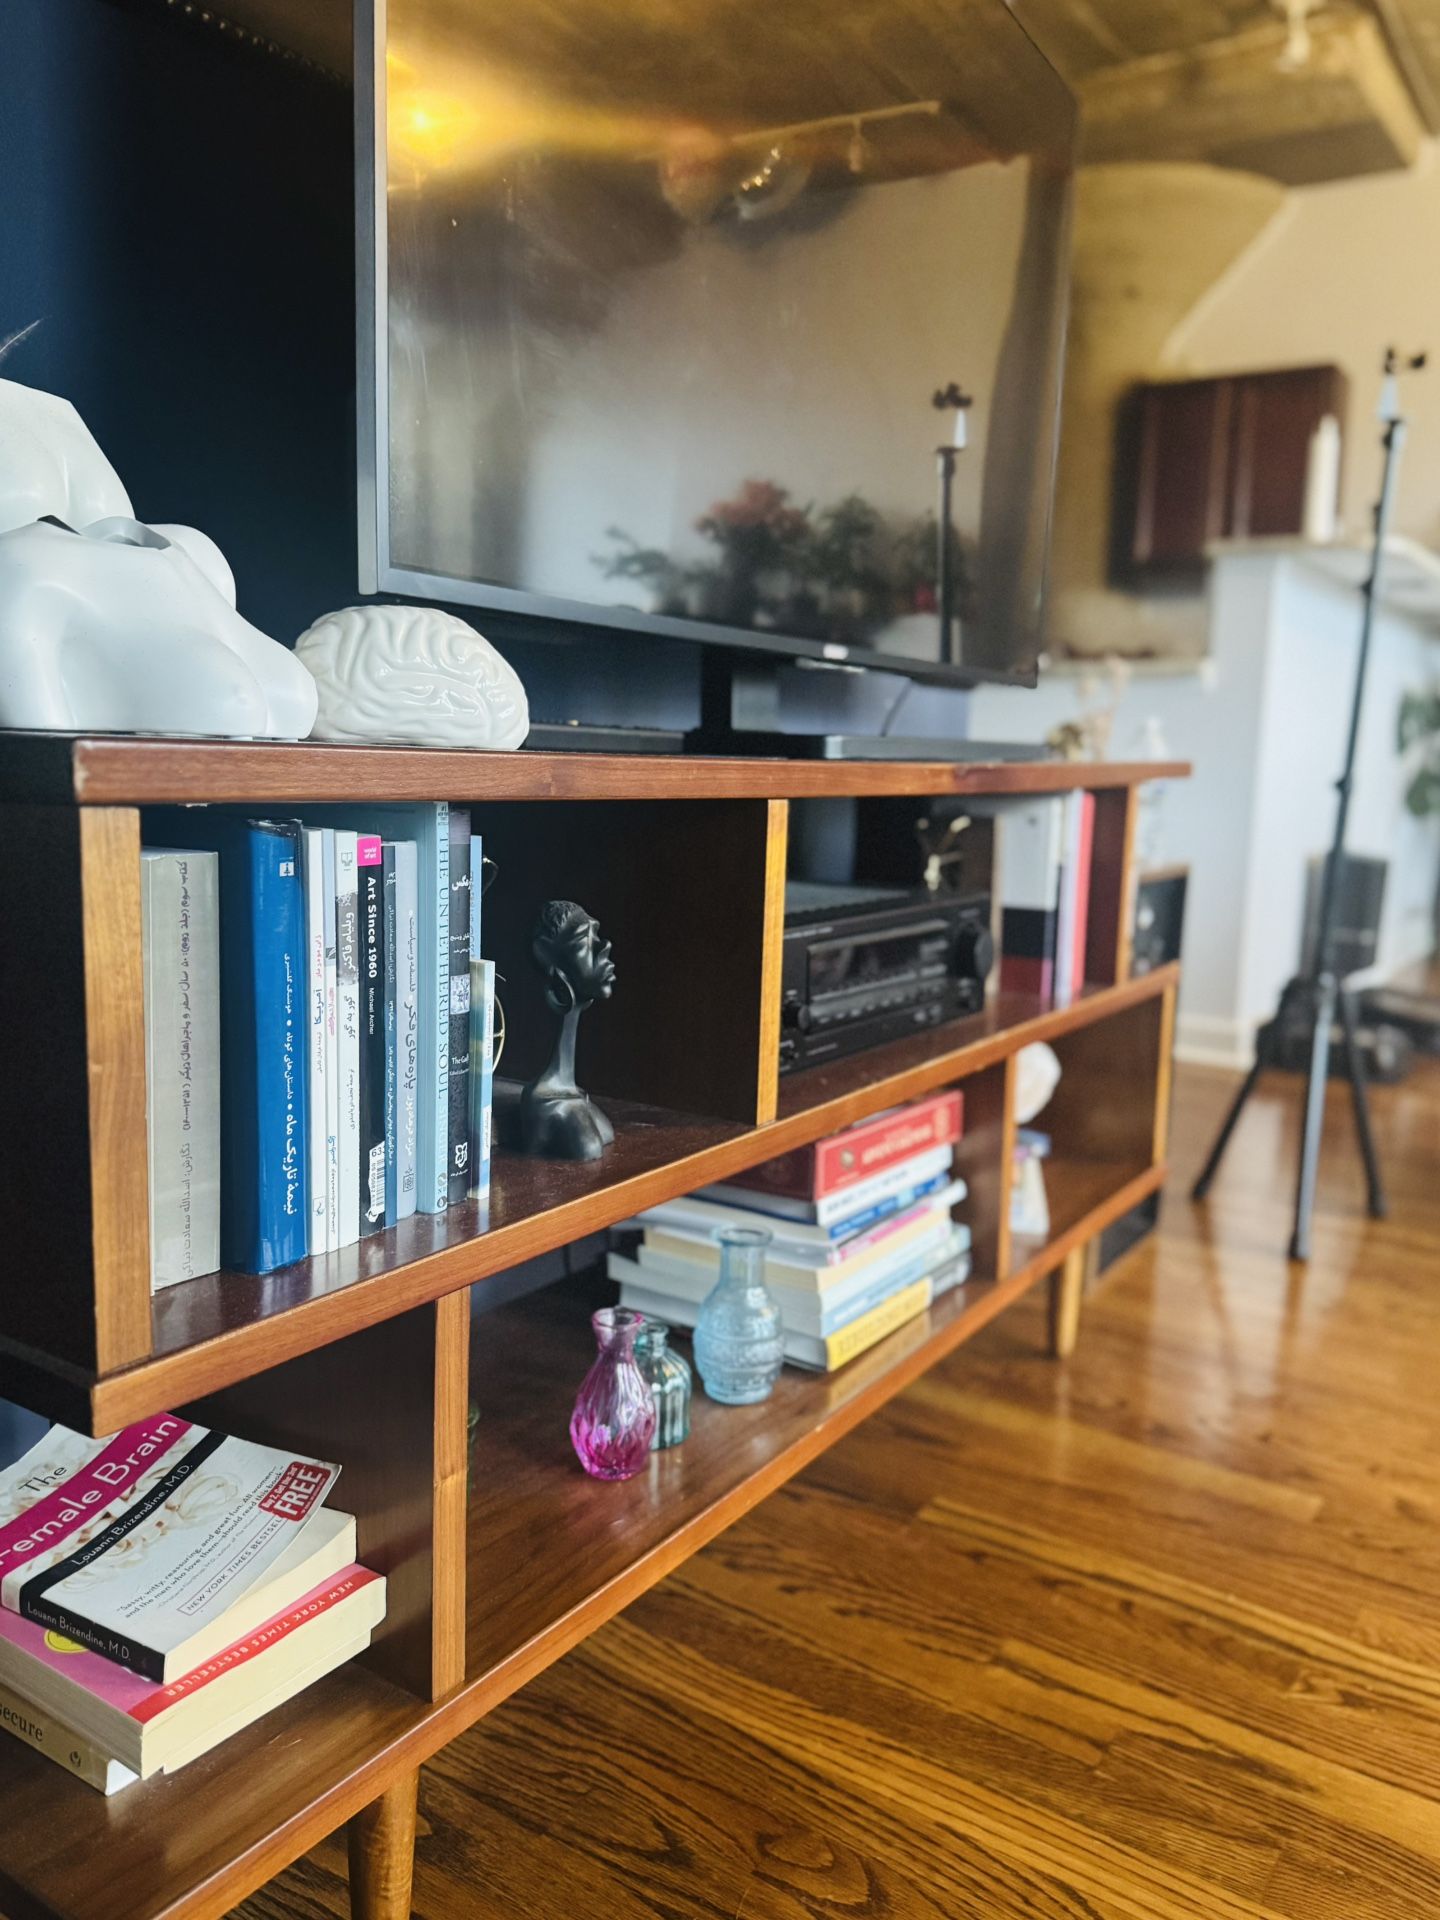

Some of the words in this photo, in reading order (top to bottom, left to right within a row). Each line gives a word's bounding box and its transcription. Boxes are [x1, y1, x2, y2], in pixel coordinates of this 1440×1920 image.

[439, 835, 448, 879] THE
[180, 886, 190, 907] سوم
[367, 877, 376, 900] Art
[341, 912, 356, 942] ویلیام
[368, 904, 376, 944] Since
[408, 917, 416, 954] سیاست
[284, 953, 294, 984] گلشیری
[342, 945, 356, 971] فاکنر
[368, 948, 377, 978] 1960
[439, 887, 448, 1035] UNTETHERED
[178, 971, 190, 991] سال
[181, 993, 191, 1010] سفر
[284, 984, 294, 1014] هوشنگ
[314, 989, 324, 1024] آمریکا
[344, 996, 356, 1010] گور
[368, 988, 376, 1012] Michael
[346, 1012, 355, 1022] به
[368, 1014, 376, 1034] Archer
[404, 1002, 417, 1031] فکر
[284, 1031, 294, 1052] کوتاه
[344, 1025, 356, 1039] گور
[178, 1062, 192, 1080] دیگر
[438, 1043, 448, 1099] SOUL
[452, 1056, 460, 1064] The
[460, 1053, 470, 1063] Gad
[286, 1114, 297, 1135] ماه
[179, 1143, 193, 1176] نگارش:
[282, 1138, 298, 1180] تاریک
[372, 1147, 384, 1157] 63
[406, 1137, 414, 1156] مراد
[180, 1179, 192, 1212] اسدالله
[182, 1214, 192, 1249] سعادت
[92, 1418, 180, 1486] Brain
[18, 1466, 67, 1492] The
[273, 1467, 322, 1516] FREE
[72, 1537, 114, 1566] Louann
[112, 1490, 169, 1537] Brizendine,
[166, 1464, 193, 1487] M.D.
[262, 1499, 276, 1508] Buy
[202, 1534, 216, 1547] and
[214, 1516, 232, 1536] great
[125, 1606, 140, 1618] and
[140, 1596, 154, 1610] the
[154, 1583, 171, 1600] men
[170, 1571, 187, 1586] who
[184, 1556, 202, 1573] love
[242, 1500, 257, 1518] read
[255, 1486, 270, 1504] this
[186, 1594, 206, 1611] NEW
[206, 1574, 229, 1594] YORK
[226, 1551, 252, 1576] TIMES
[250, 1516, 284, 1550] BESTSEL
[328, 1581, 354, 1600] NEW
[294, 1599, 326, 1622] YORK
[28, 1602, 57, 1626] Louann
[59, 1616, 107, 1650] Brizendine,
[108, 1640, 132, 1661] M.D.
[251, 1622, 291, 1646] TIMES
[166, 1648, 249, 1697] BESTSELLER
[0, 1702, 44, 1742] ecure
